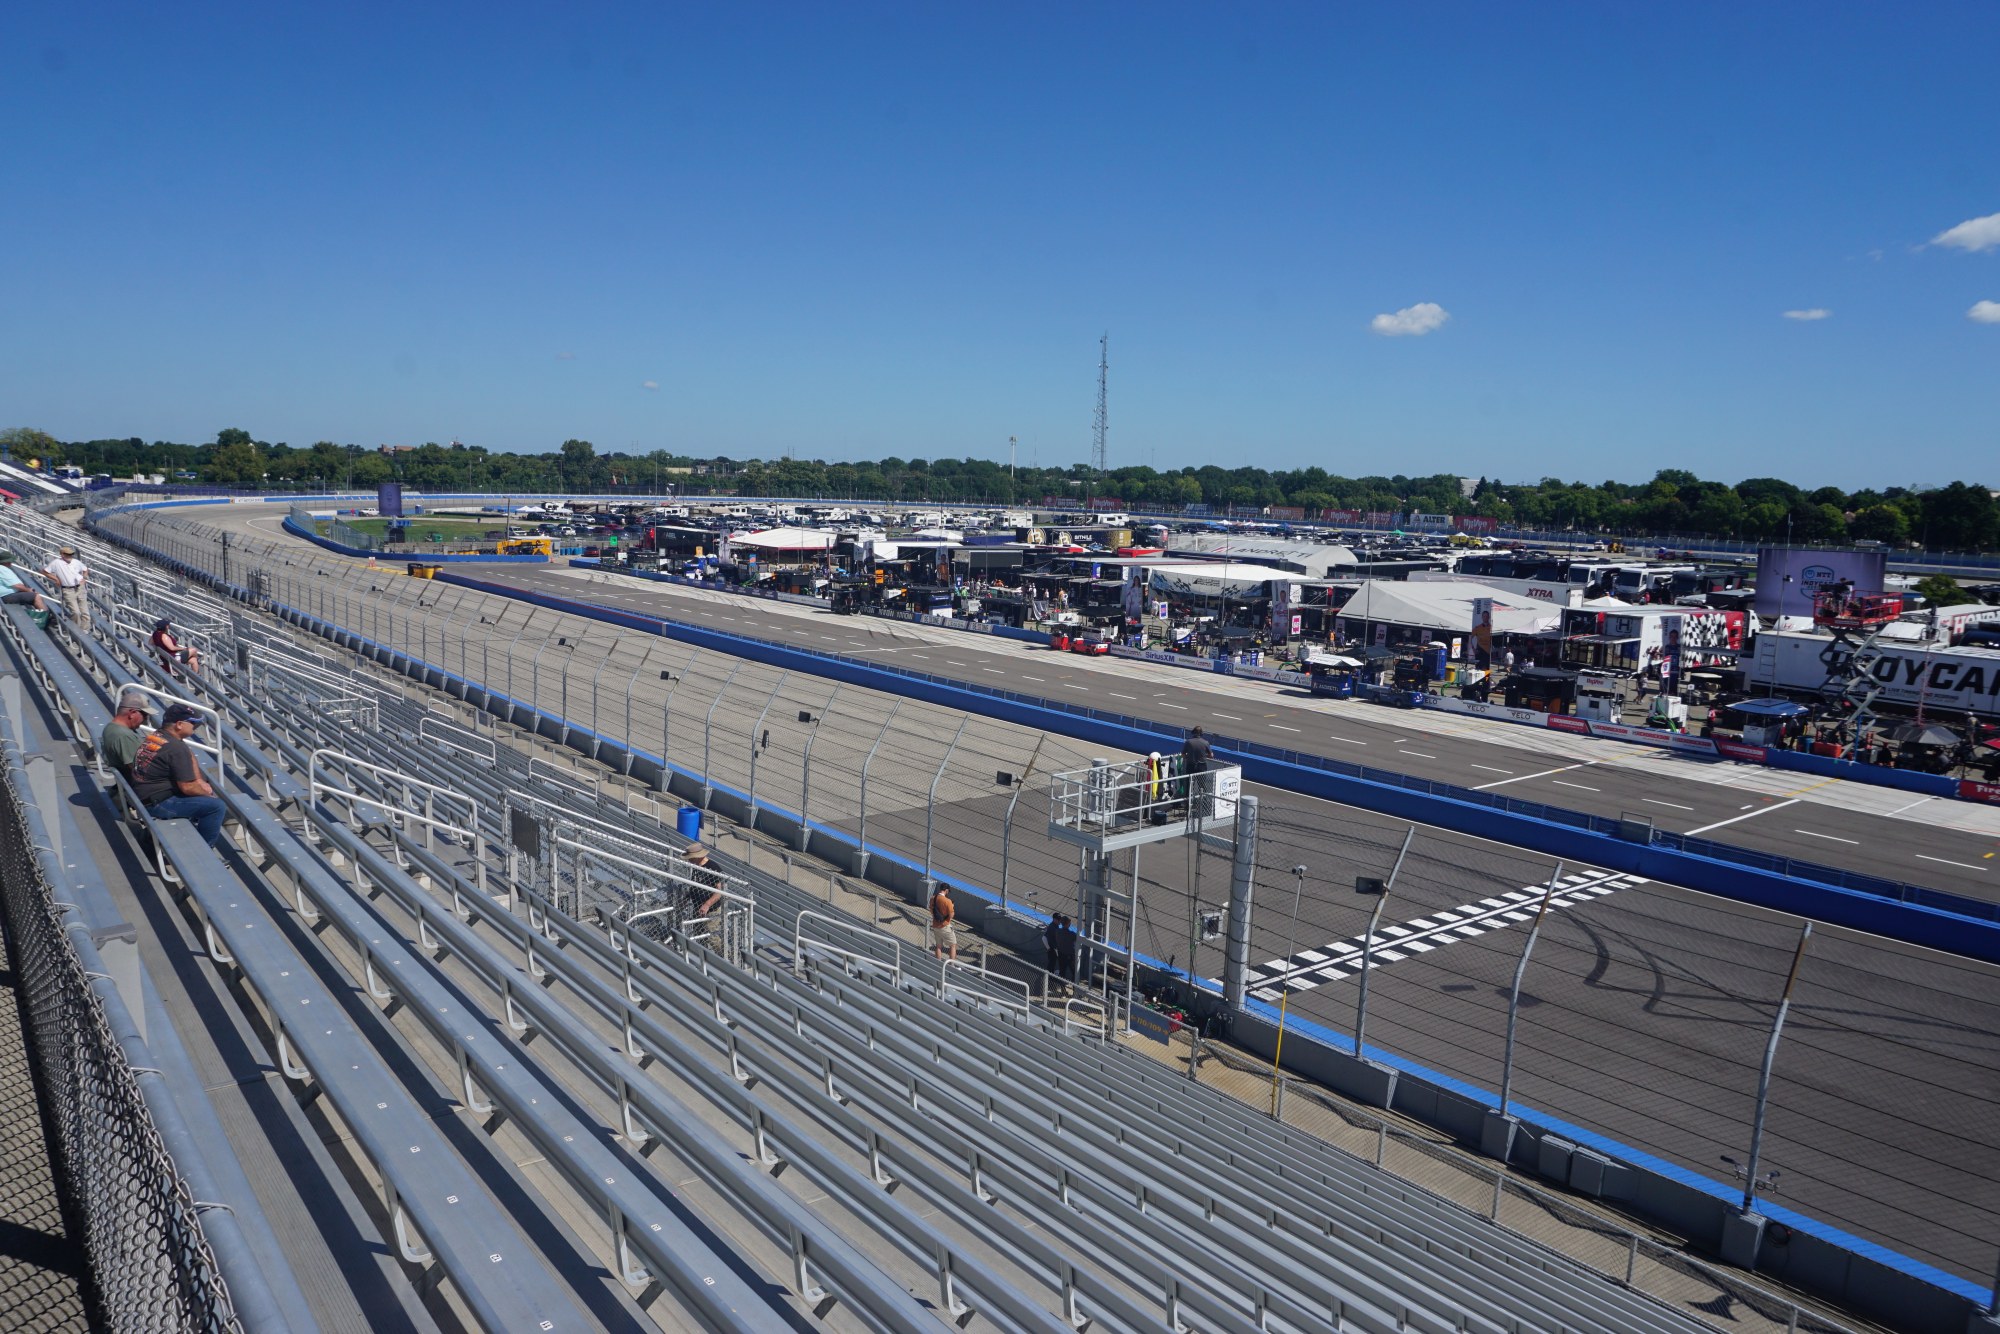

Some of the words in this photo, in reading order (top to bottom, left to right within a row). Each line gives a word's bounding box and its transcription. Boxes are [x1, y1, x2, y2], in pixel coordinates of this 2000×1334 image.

[1423, 516, 1446, 524] ALTER
[1525, 587, 1553, 599] XTRA
[1145, 651, 1175, 662] SiriusXM
[1467, 704, 1486, 713] VELO
[1512, 711, 1531, 720] VELO
